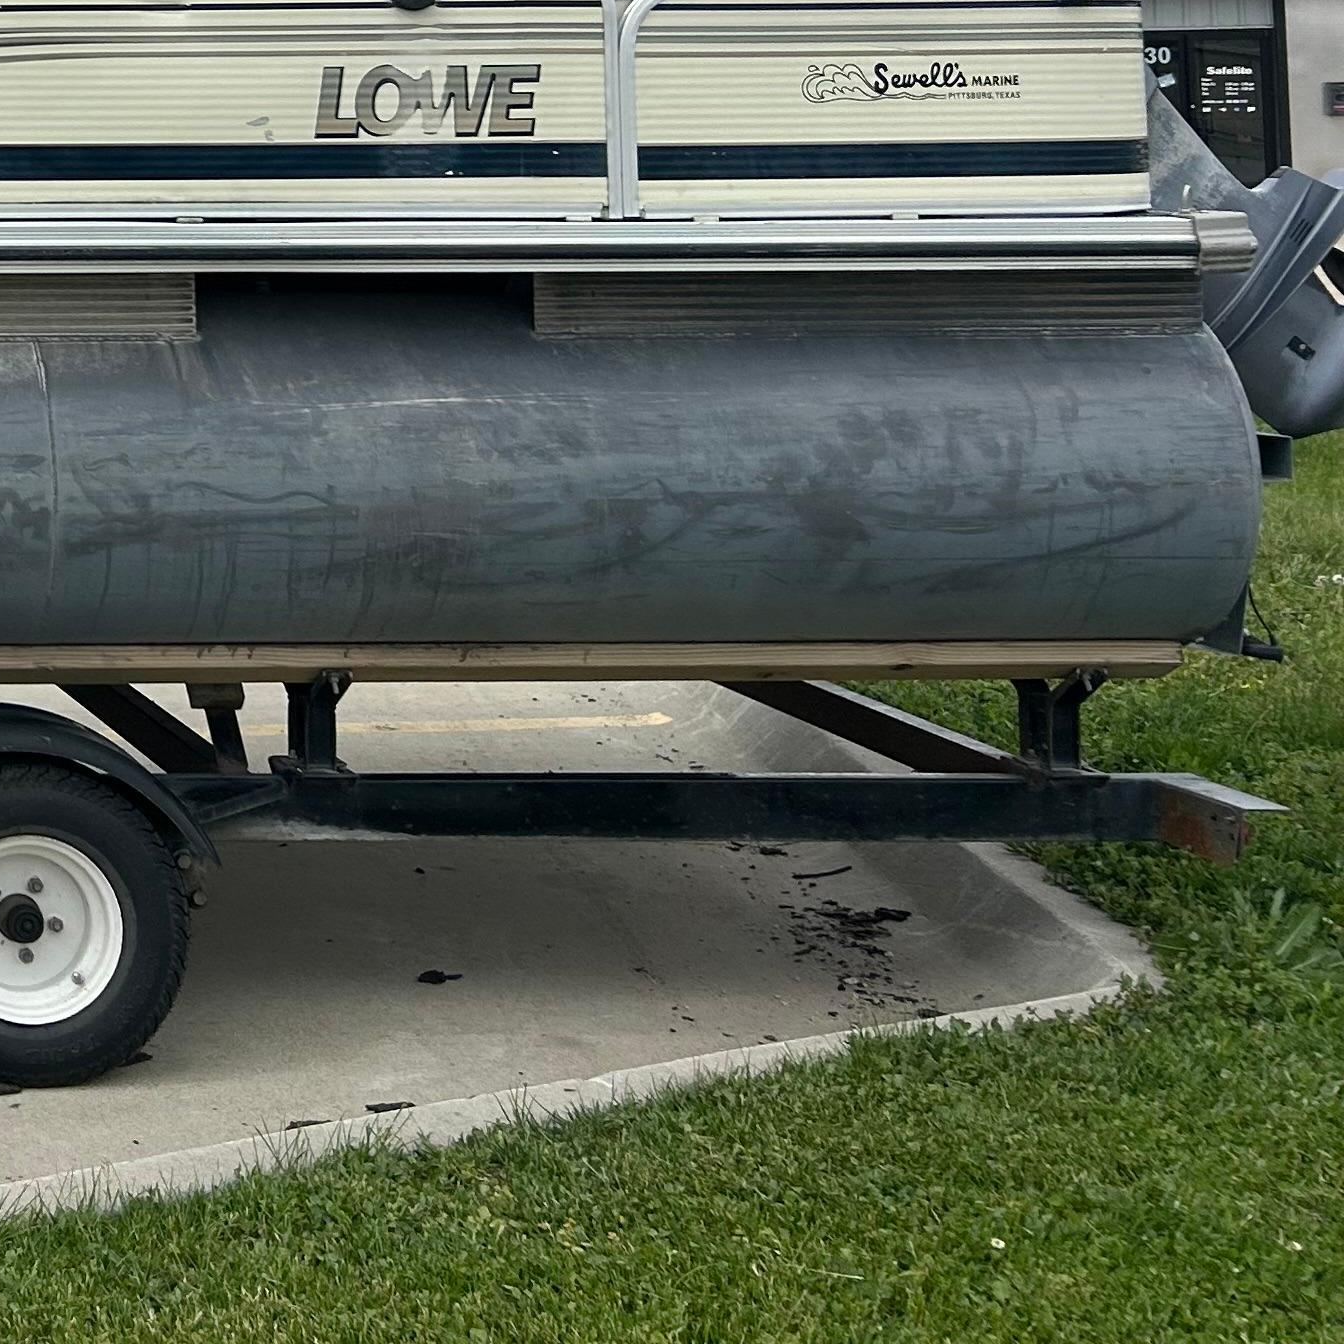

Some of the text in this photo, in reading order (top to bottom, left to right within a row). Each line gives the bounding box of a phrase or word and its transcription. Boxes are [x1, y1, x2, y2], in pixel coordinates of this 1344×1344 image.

[874, 62, 1020, 95] Sewell's MARINE
[996, 91, 1021, 99] TEXAS
[314, 64, 542, 139] LOWE
